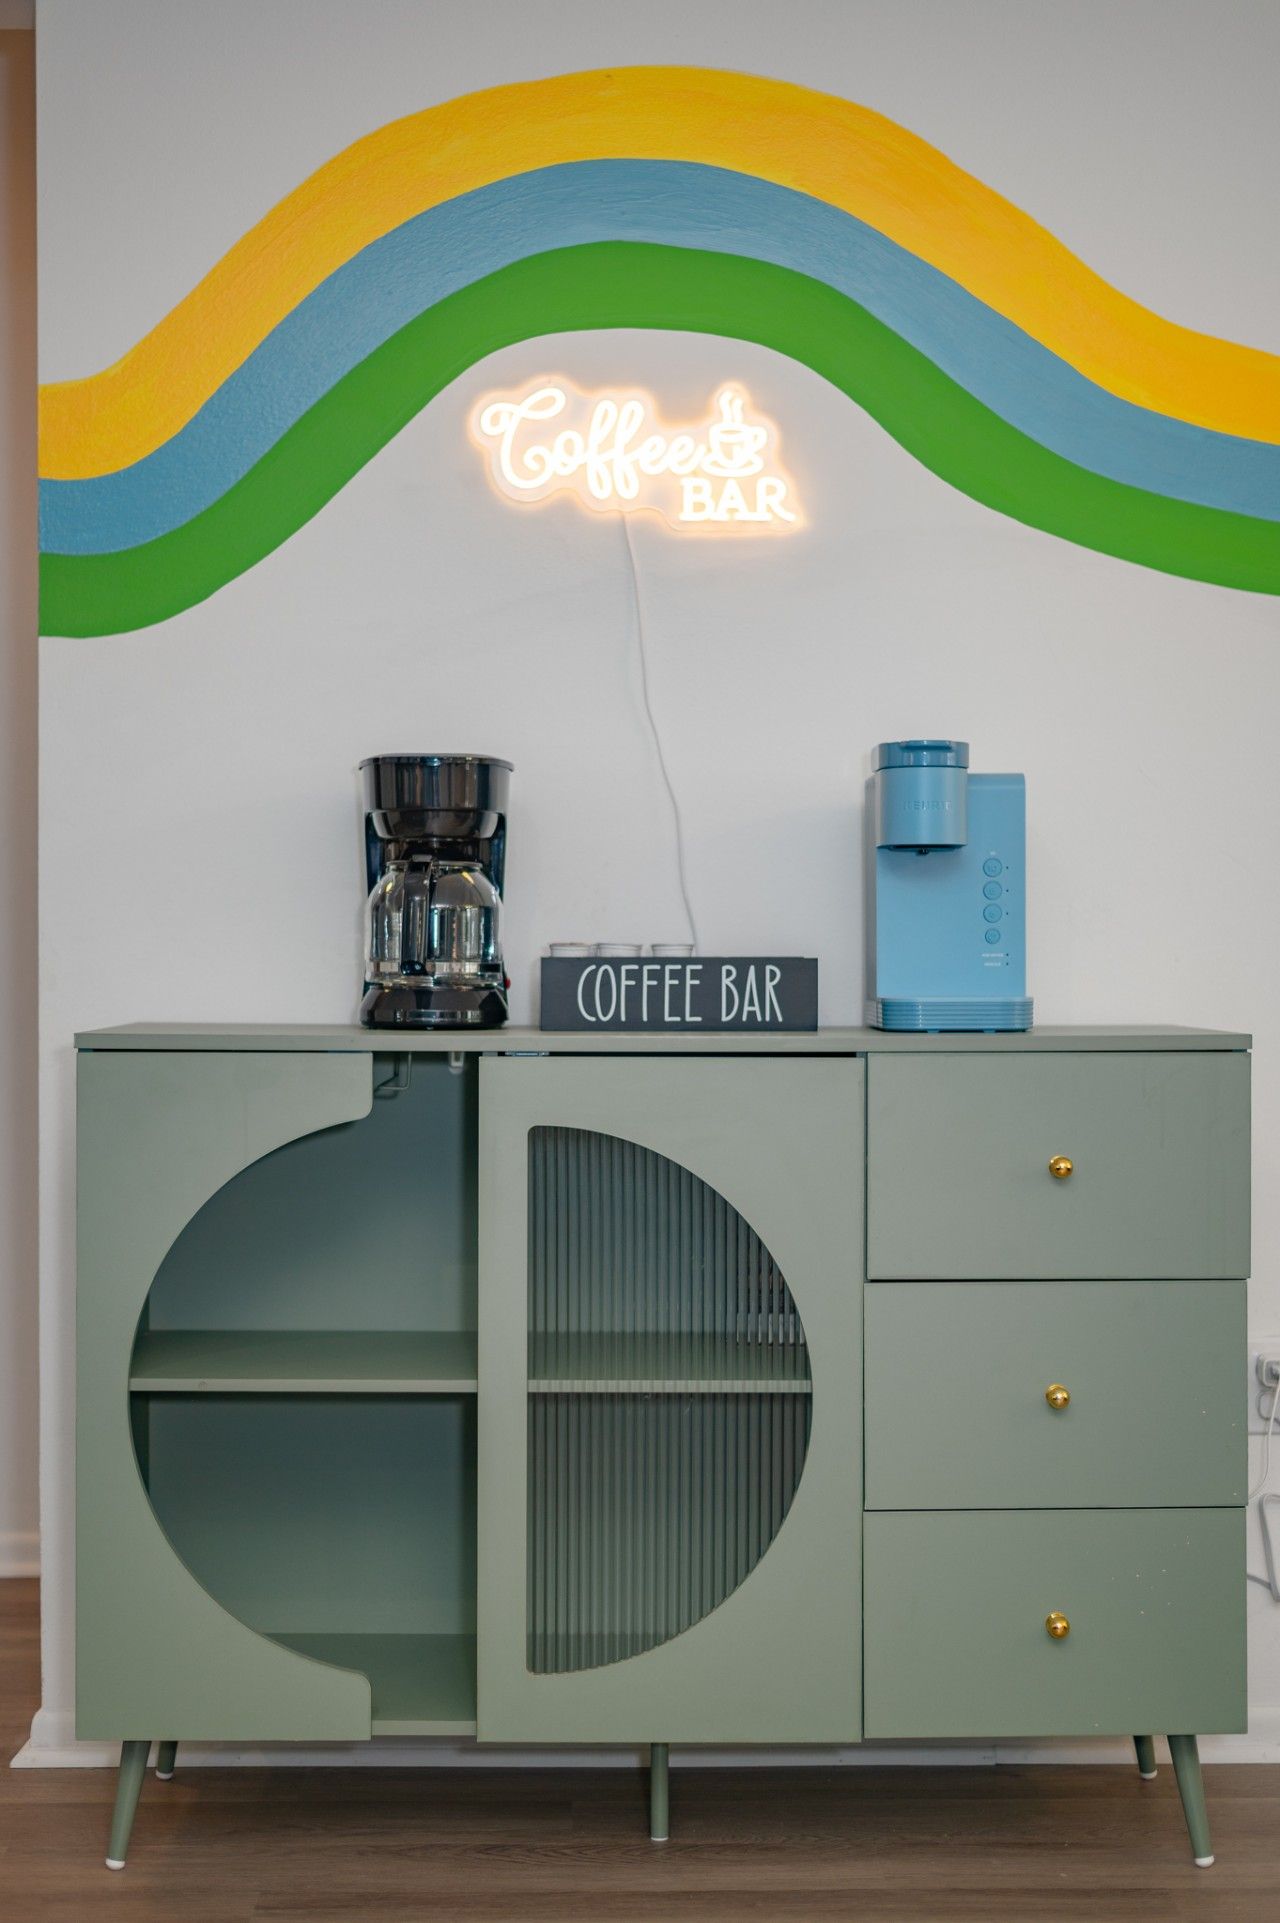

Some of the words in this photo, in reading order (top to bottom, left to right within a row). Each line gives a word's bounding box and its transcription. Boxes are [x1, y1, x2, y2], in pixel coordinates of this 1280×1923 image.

[480, 387, 709, 499] Coffee
[679, 476, 797, 522] BAR
[577, 964, 703, 1022] COFFEE
[720, 964, 783, 1022] BAR
